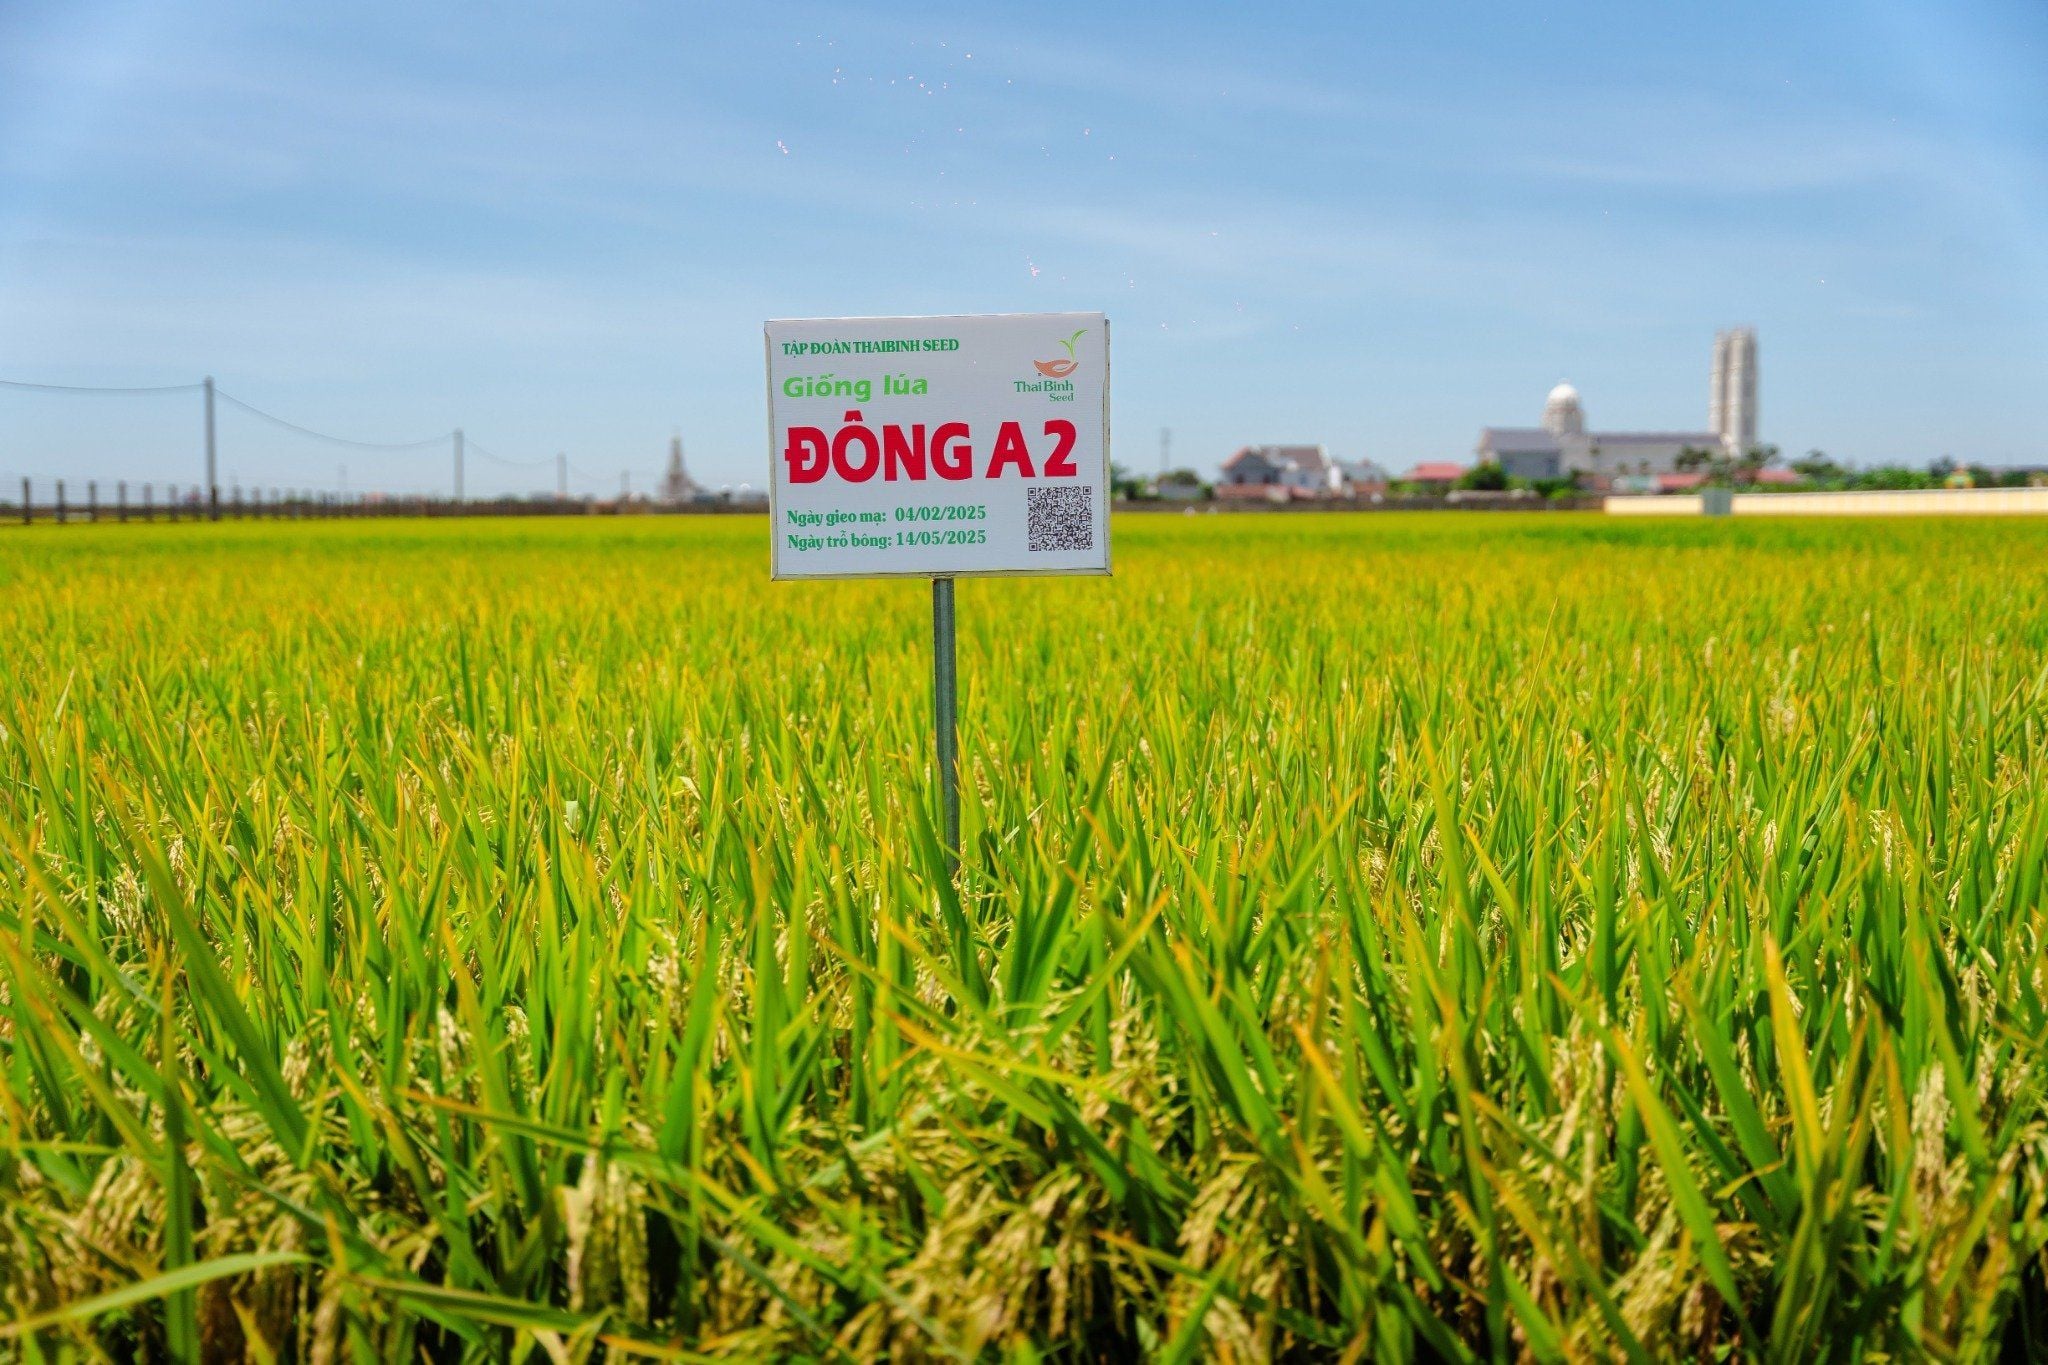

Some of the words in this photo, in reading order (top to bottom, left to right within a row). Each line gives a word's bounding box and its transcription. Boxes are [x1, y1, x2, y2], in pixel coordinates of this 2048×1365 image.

[810, 338, 851, 355] ĐOÀN
[852, 340, 920, 354] THAIBINH
[922, 338, 960, 352] SEED
[783, 373, 871, 402] Giống
[883, 373, 928, 395] lúa
[1049, 392, 1074, 402] Seed
[784, 409, 973, 484] ĐÔNG
[985, 421, 1036, 478] A
[1044, 419, 1077, 477] 2
[786, 510, 824, 527] Ngày
[826, 509, 857, 527] gieo
[860, 511, 887, 526] mạ:
[894, 505, 986, 522] 04/02/2025
[787, 534, 824, 551] Ngày
[851, 533, 892, 549] bông:
[896, 529, 986, 546] 14/05/2025
